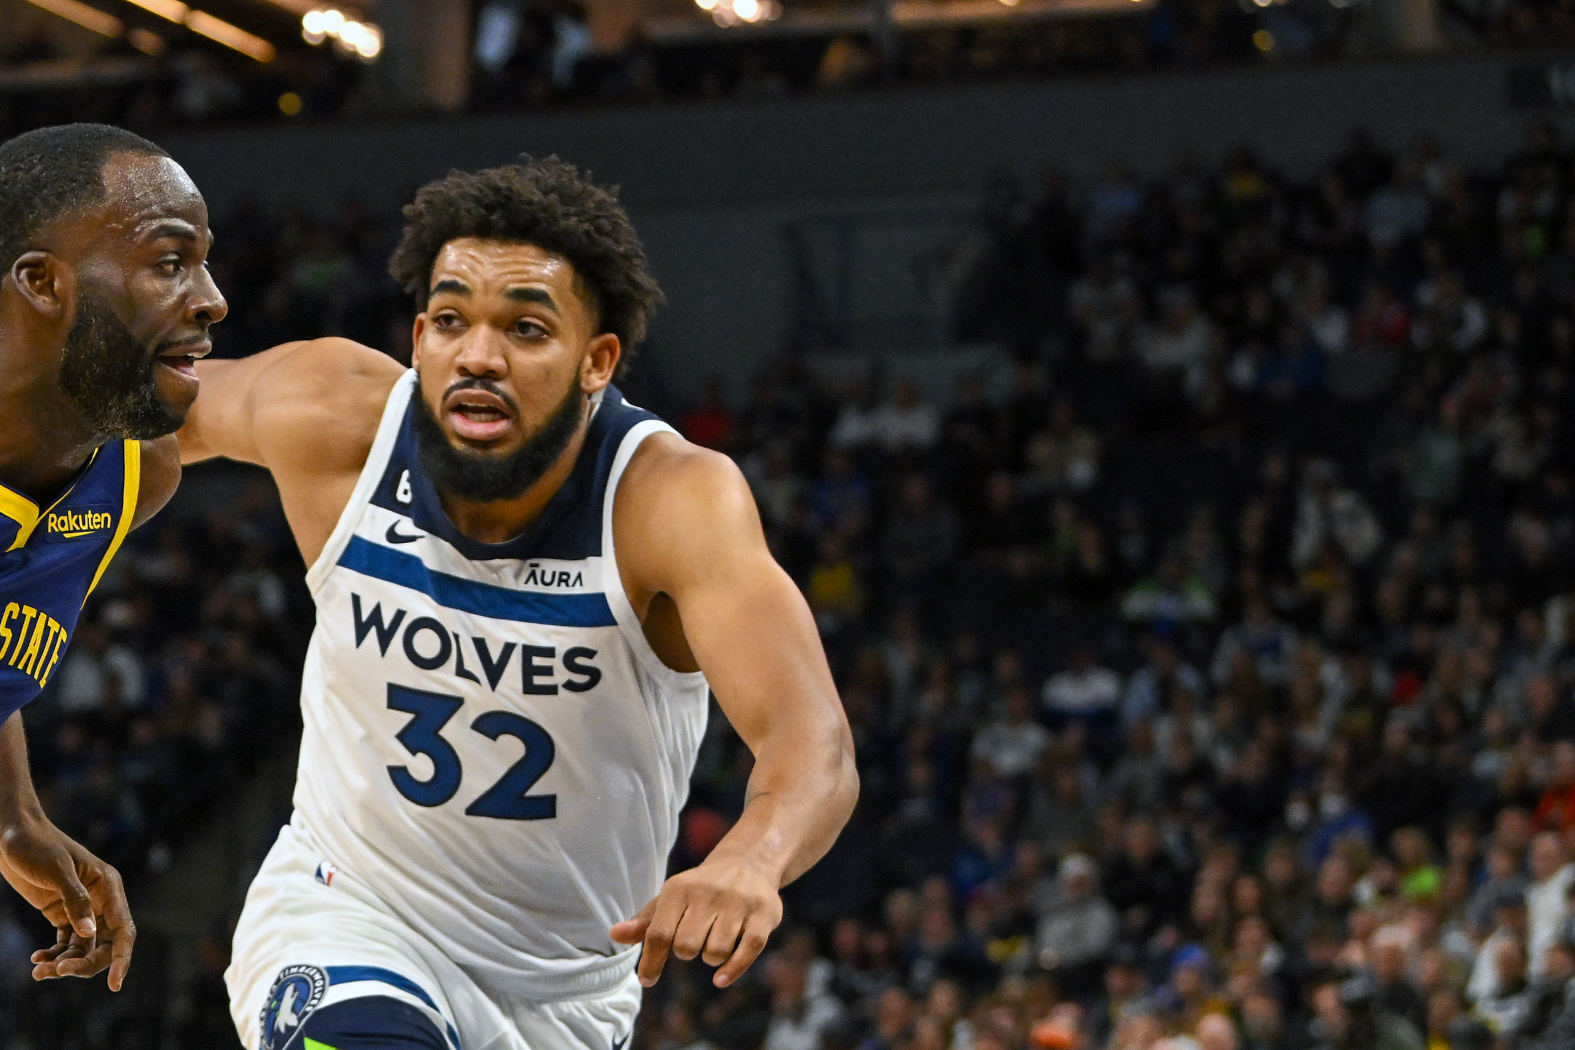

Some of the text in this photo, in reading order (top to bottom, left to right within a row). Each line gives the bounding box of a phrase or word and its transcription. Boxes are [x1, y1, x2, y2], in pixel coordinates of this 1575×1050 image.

[47, 509, 112, 534] Rakuten
[395, 468, 413, 505] 6
[350, 591, 603, 696] WOLVES
[385, 681, 558, 821] 32
